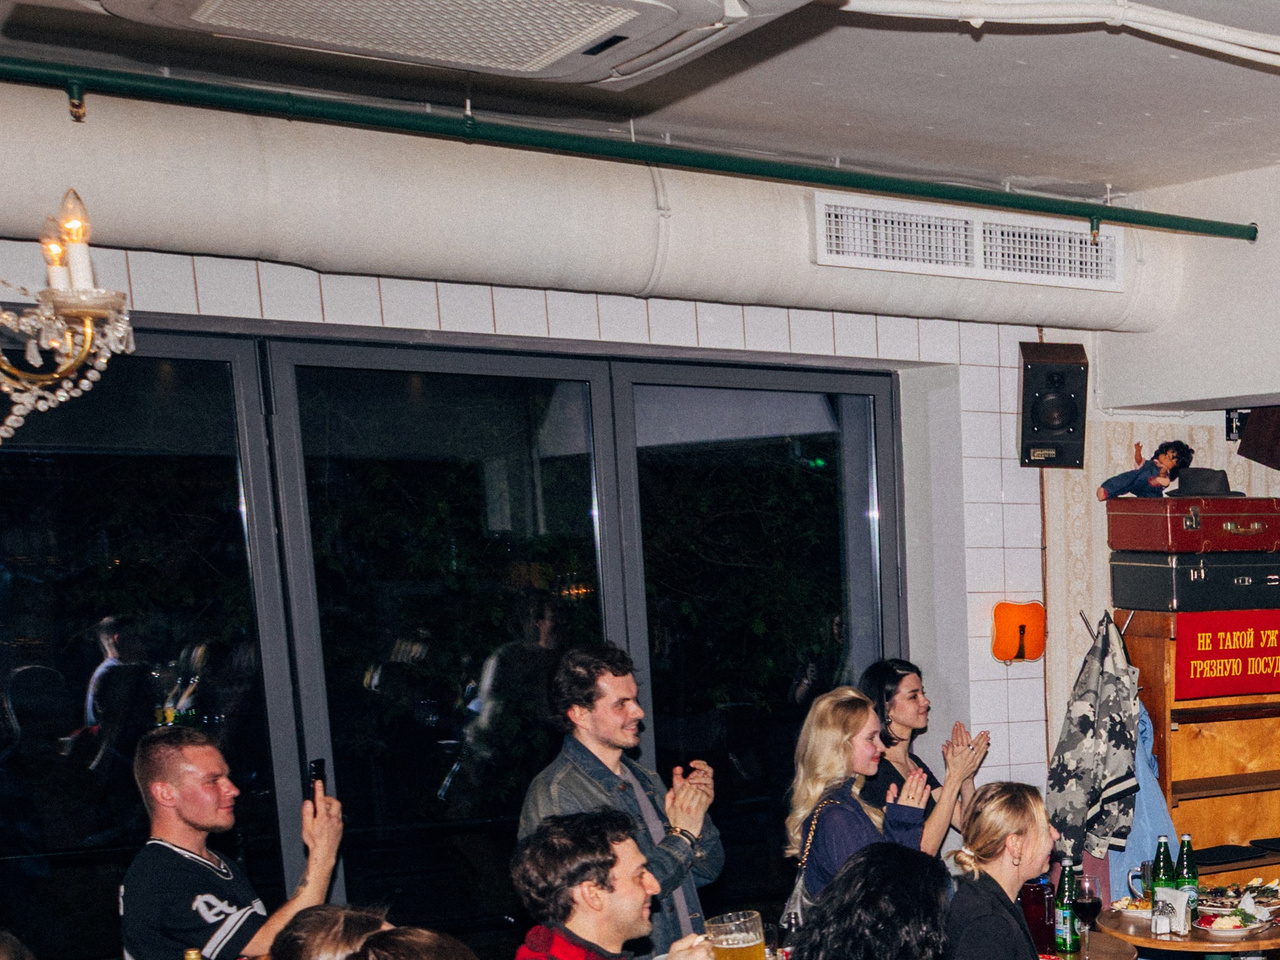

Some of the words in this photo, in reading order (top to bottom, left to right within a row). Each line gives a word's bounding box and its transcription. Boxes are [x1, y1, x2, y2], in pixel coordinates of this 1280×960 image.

[1197, 633, 1212, 651] НЕ
[1218, 628, 1255, 650] ТАКОЙ
[1260, 629, 1279, 648] УЖ
[1189, 658, 1242, 679] ГРЯЗНУЮ
